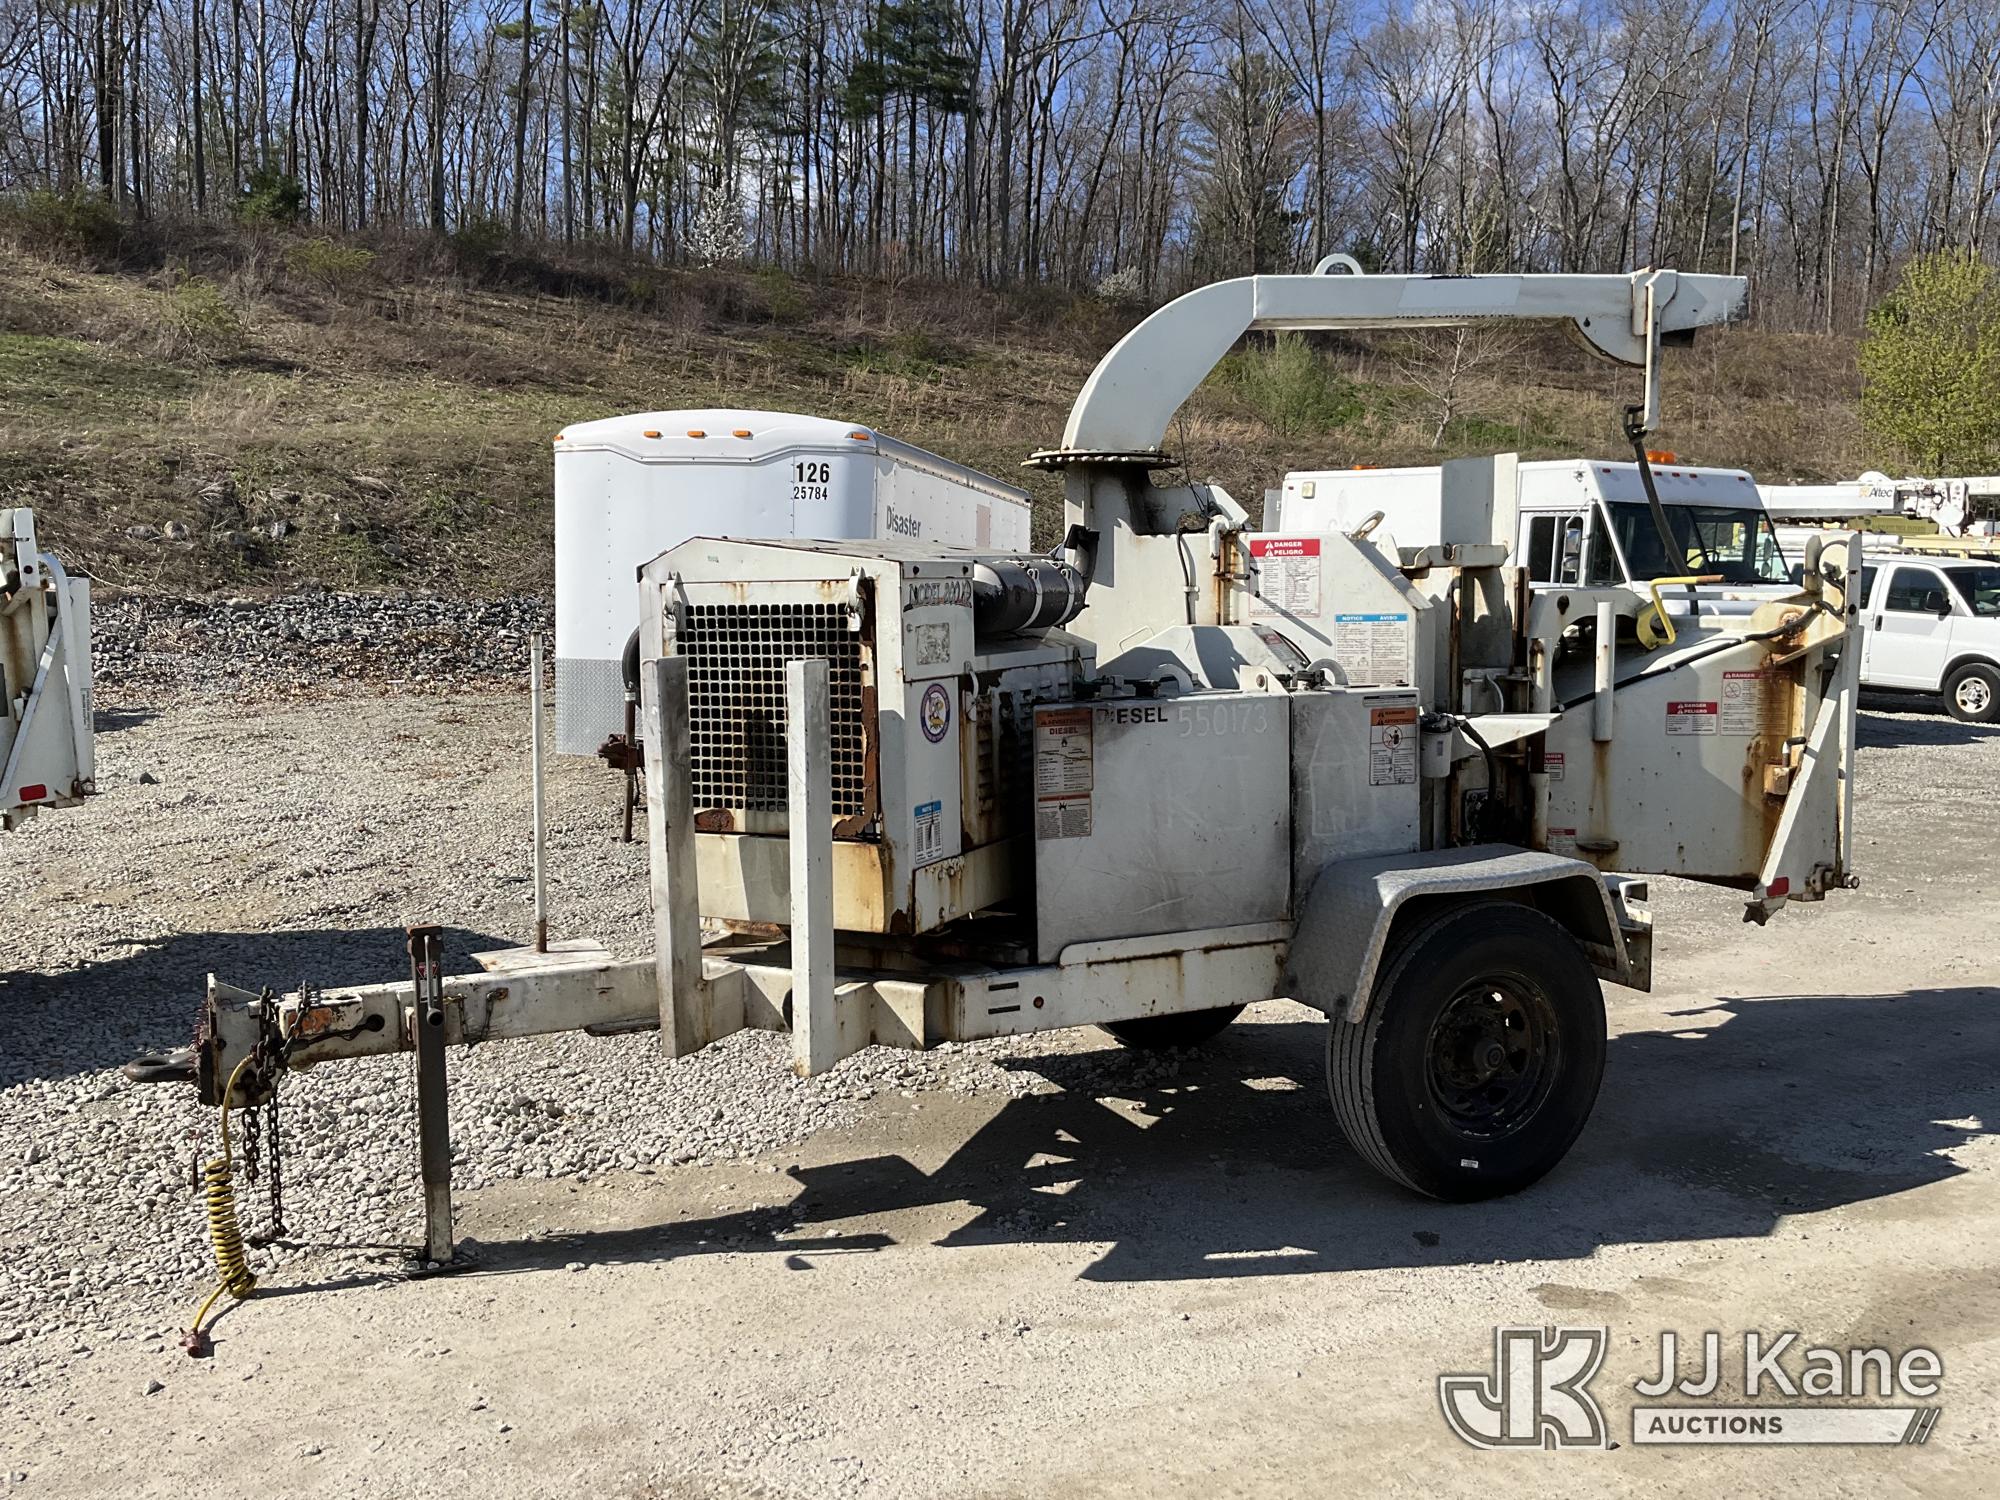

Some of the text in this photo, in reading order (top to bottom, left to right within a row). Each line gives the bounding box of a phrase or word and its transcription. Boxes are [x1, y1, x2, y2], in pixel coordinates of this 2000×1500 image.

[796, 462, 830, 483] 126
[793, 486, 828, 500] 25784
[1869, 487, 1893, 498] Altec
[886, 505, 921, 538] Disaster
[1178, 703, 1268, 738] 550173
[1049, 727, 1079, 735] DIESEL
